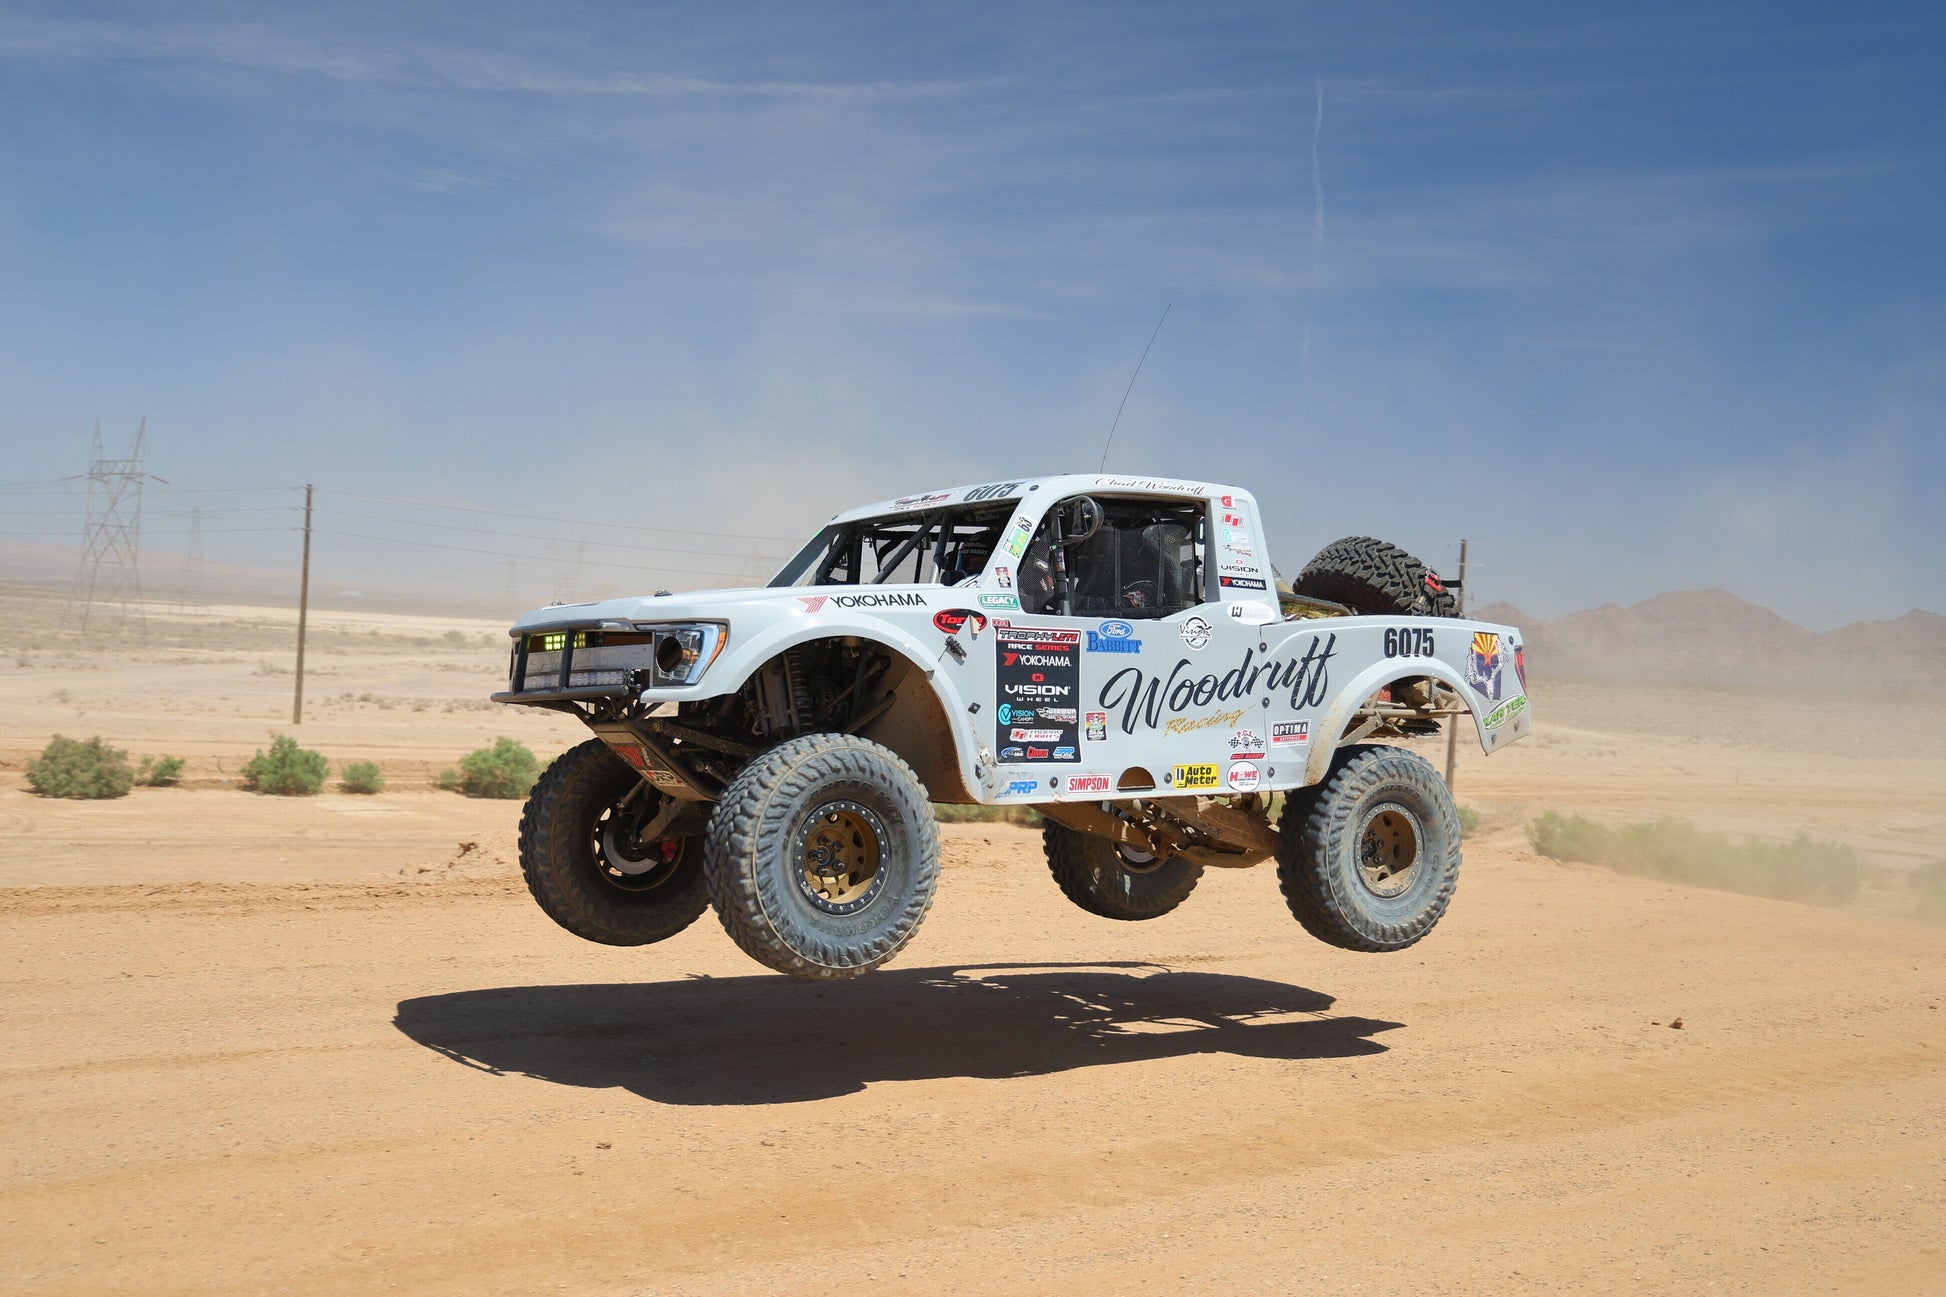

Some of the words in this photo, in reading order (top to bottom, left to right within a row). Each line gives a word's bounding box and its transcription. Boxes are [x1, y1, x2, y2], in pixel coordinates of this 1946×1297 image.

[962, 481, 1026, 502] 6075
[1094, 478, 1137, 488] Chad
[1138, 481, 1205, 496] Woodruff
[1221, 565, 1259, 573] VISION
[1231, 579, 1264, 589] YOKOHAMA
[830, 593, 928, 608] YOKOHAMA
[981, 596, 1016, 605] LEGACY
[999, 630, 1079, 642] TROPHYLITE
[1106, 623, 1126, 636] Ford
[1085, 630, 1142, 654] BABBITT
[1384, 628, 1435, 659] 6075
[1019, 654, 1072, 667] YOKOHAMA
[1004, 684, 1069, 696] VISION
[1098, 632, 1338, 736] Woodruff
[1011, 709, 1035, 717] VISION
[1163, 704, 1253, 738] Racing
[1273, 723, 1308, 736] OPTIMA
[1186, 766, 1212, 776] Auto
[1068, 777, 1110, 792] SIMPSON
[1185, 776, 1217, 785] Meter
